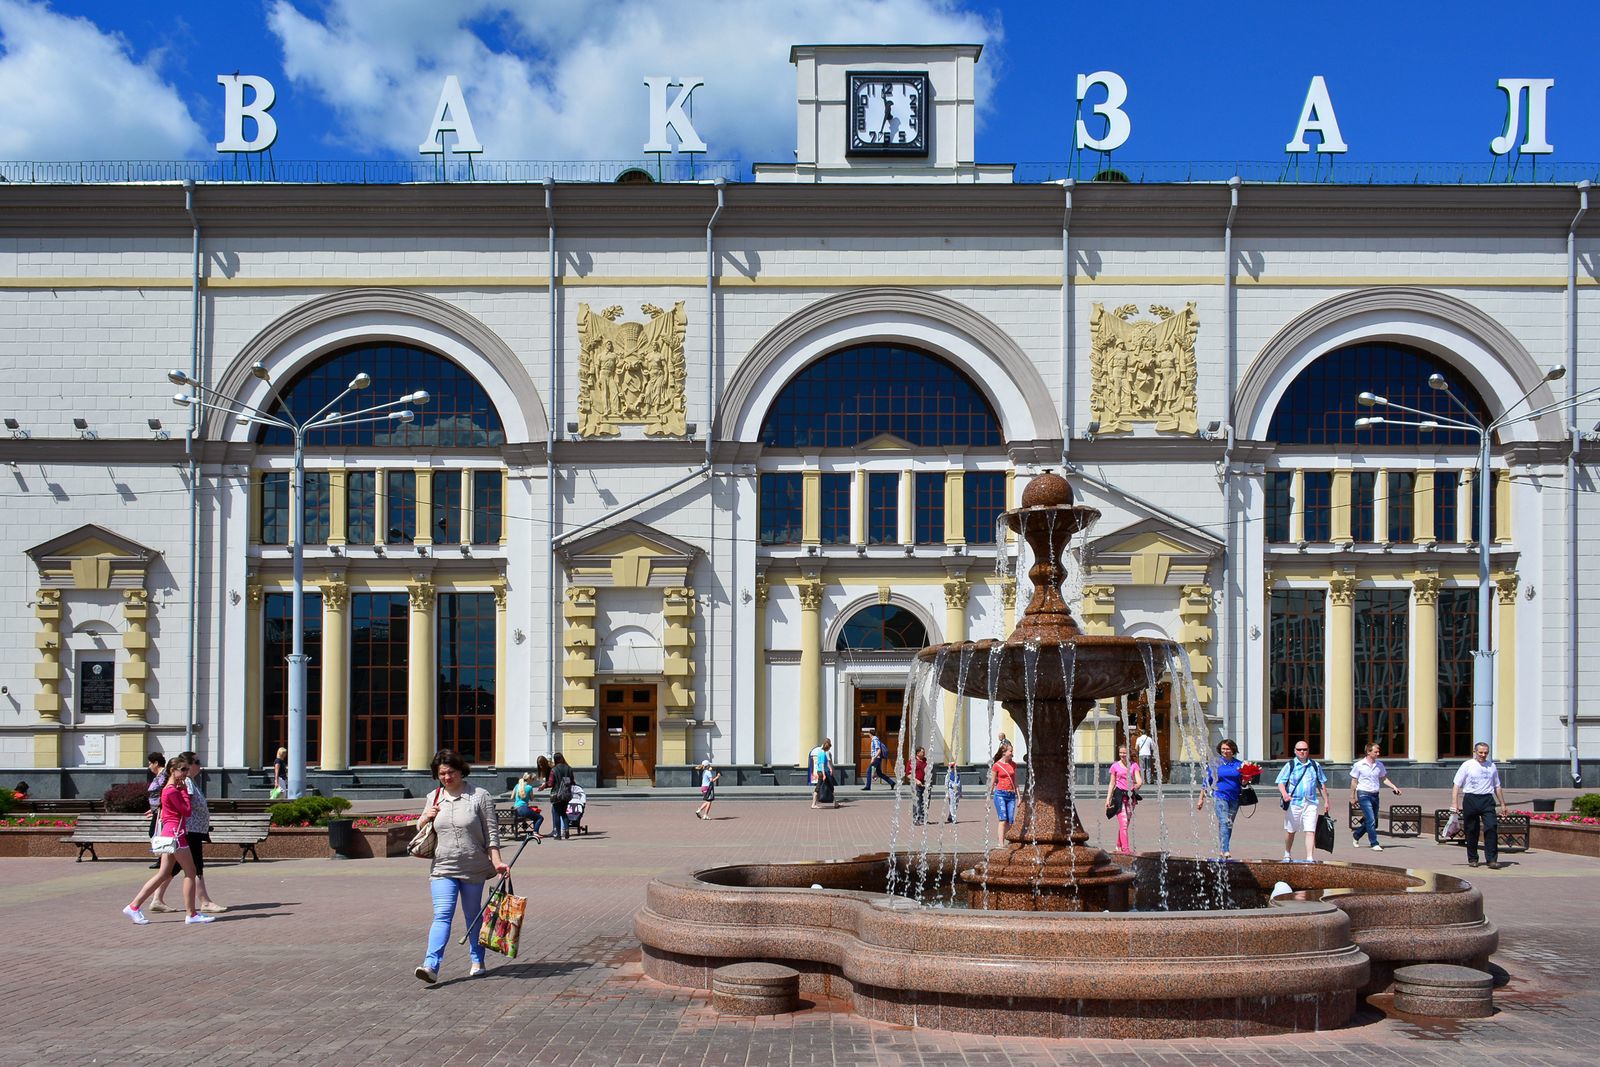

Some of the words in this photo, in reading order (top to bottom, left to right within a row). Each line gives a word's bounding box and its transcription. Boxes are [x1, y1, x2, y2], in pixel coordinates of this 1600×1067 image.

[881, 84, 892, 94] 12
[910, 95, 916, 105] 2
[216, 70, 1555, 154] ВАКЗАЛ
[899, 131, 906, 142] 5
